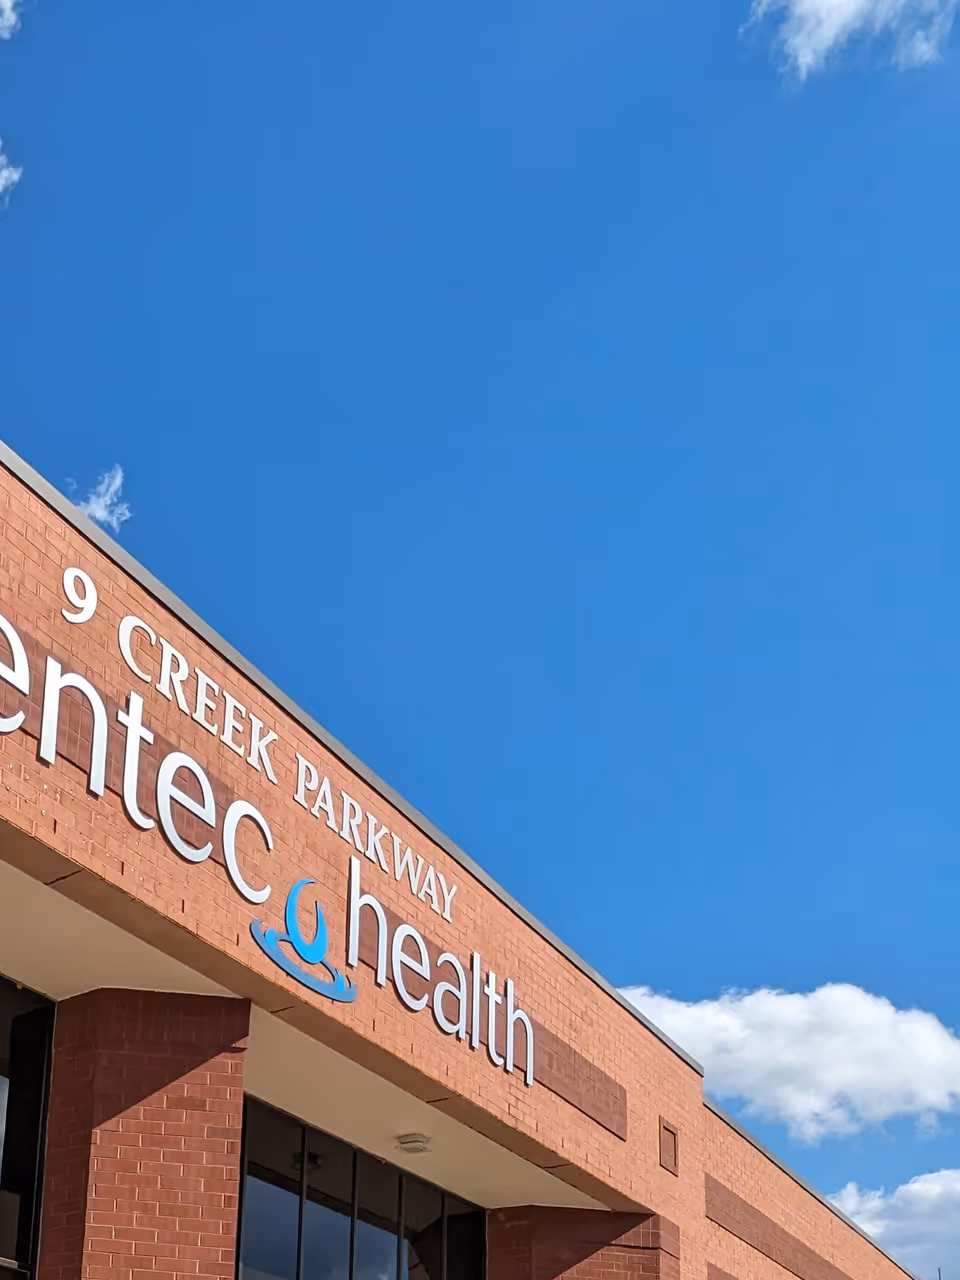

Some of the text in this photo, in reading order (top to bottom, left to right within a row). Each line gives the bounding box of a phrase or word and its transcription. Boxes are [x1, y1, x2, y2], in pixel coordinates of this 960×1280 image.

[61, 566, 458, 923] 9 CREEK PARKWAY
[347, 856, 535, 1086] health
